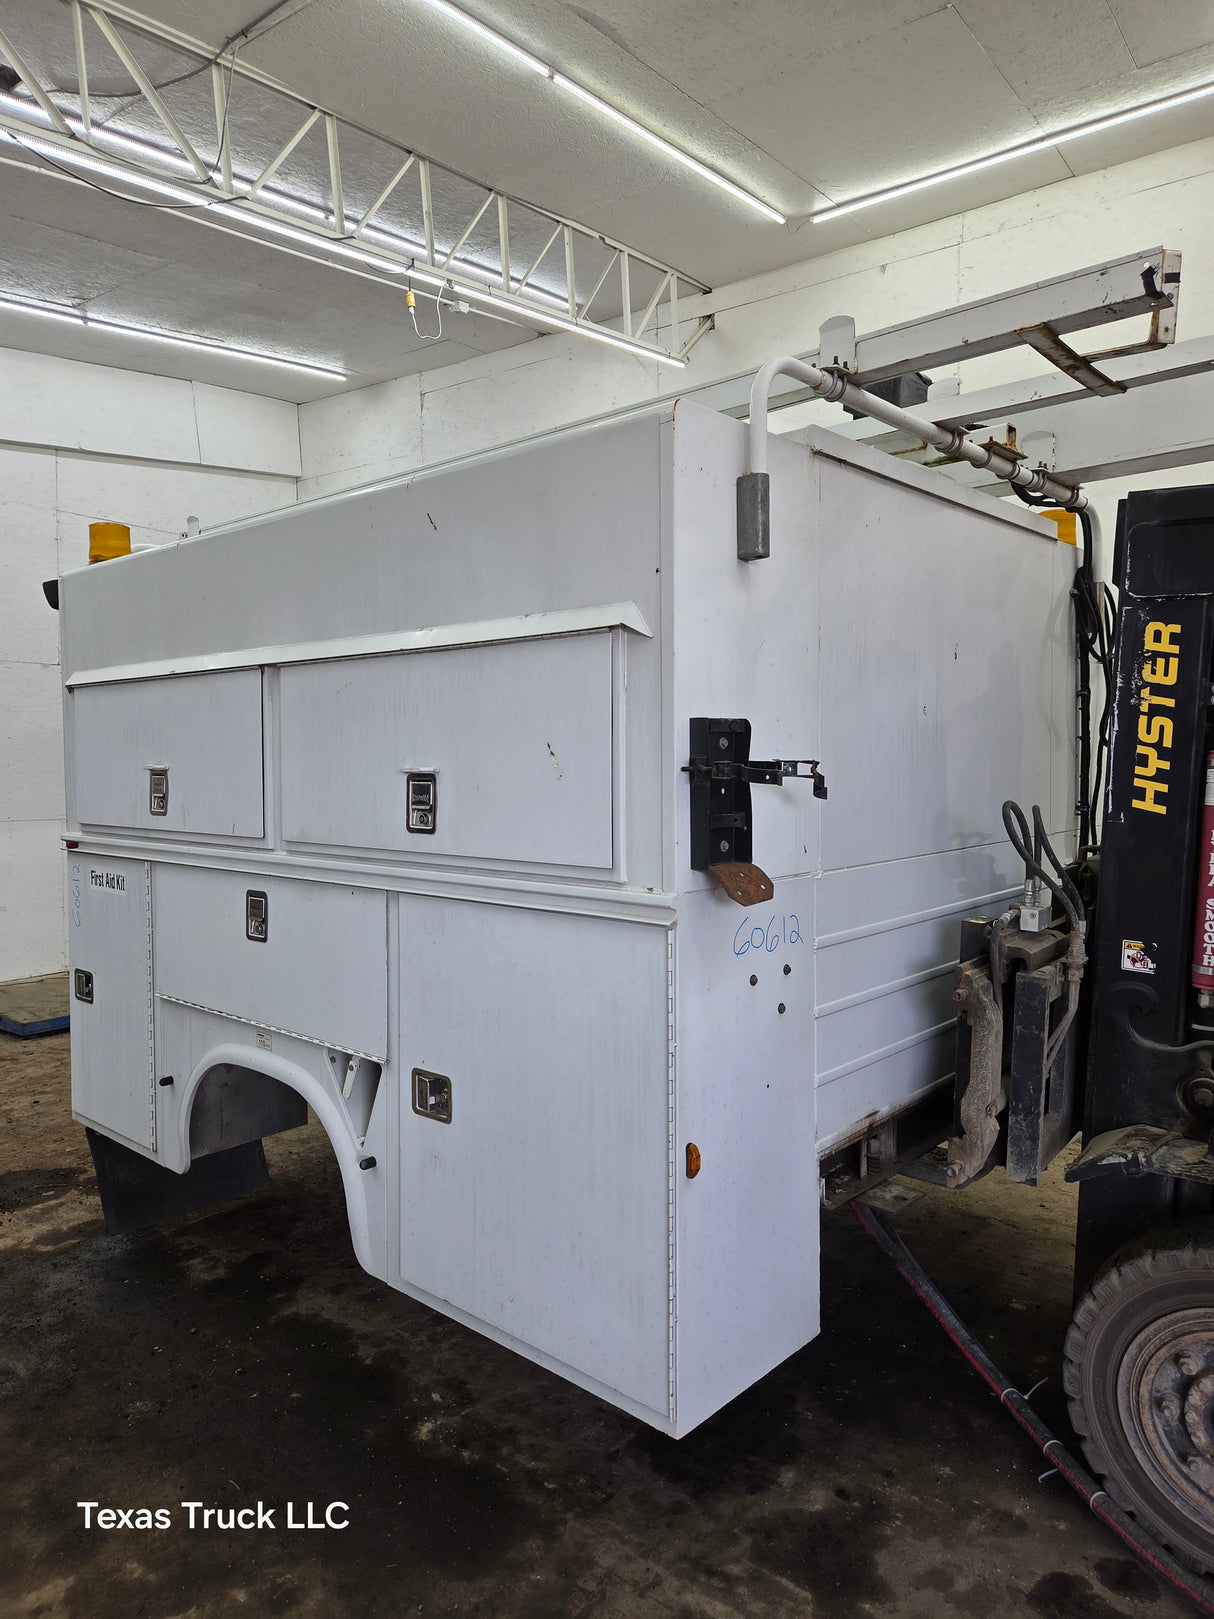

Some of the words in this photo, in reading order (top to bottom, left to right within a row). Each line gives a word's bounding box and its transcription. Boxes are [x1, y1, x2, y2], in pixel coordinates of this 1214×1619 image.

[1131, 621, 1182, 815] HYSTER
[90, 869, 105, 887] First
[105, 872, 116, 890] Aid
[116, 873, 126, 891] Kit
[733, 914, 804, 957] 60612
